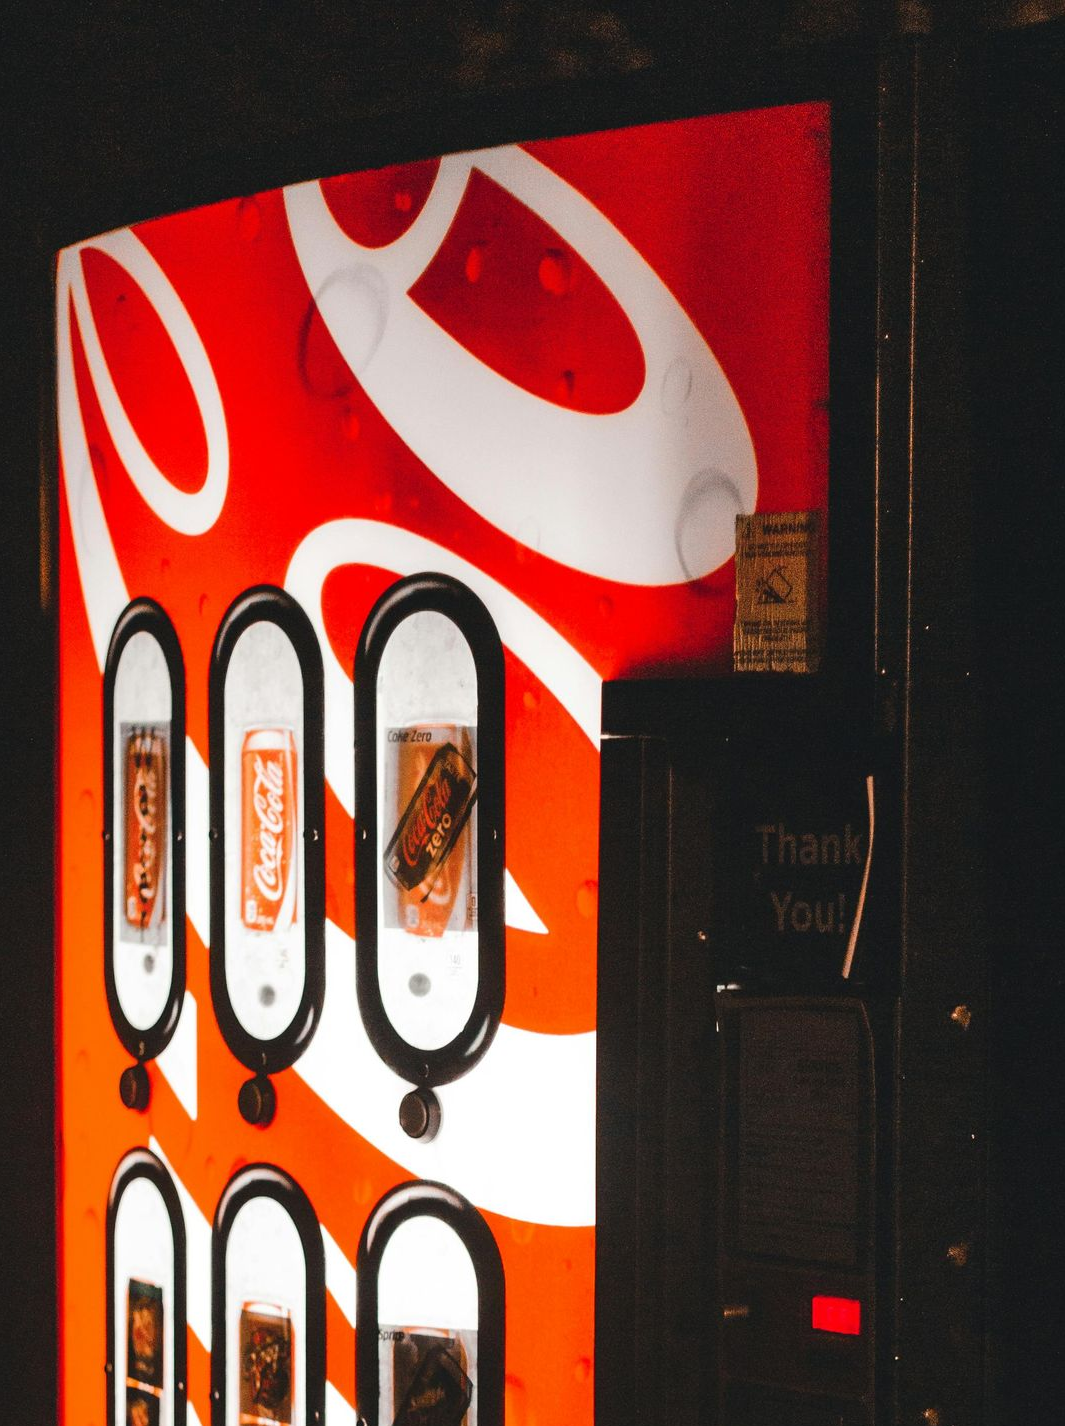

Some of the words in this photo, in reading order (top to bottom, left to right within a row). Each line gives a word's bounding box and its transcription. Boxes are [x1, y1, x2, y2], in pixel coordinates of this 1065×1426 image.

[387, 729, 409, 743] Coke
[410, 729, 432, 743] Zero
[252, 752, 284, 902] Coca-Cola
[402, 778, 452, 868] Coca-Cola
[426, 813, 452, 858] zero
[755, 823, 863, 865] Thank
[770, 890, 846, 934] You!
